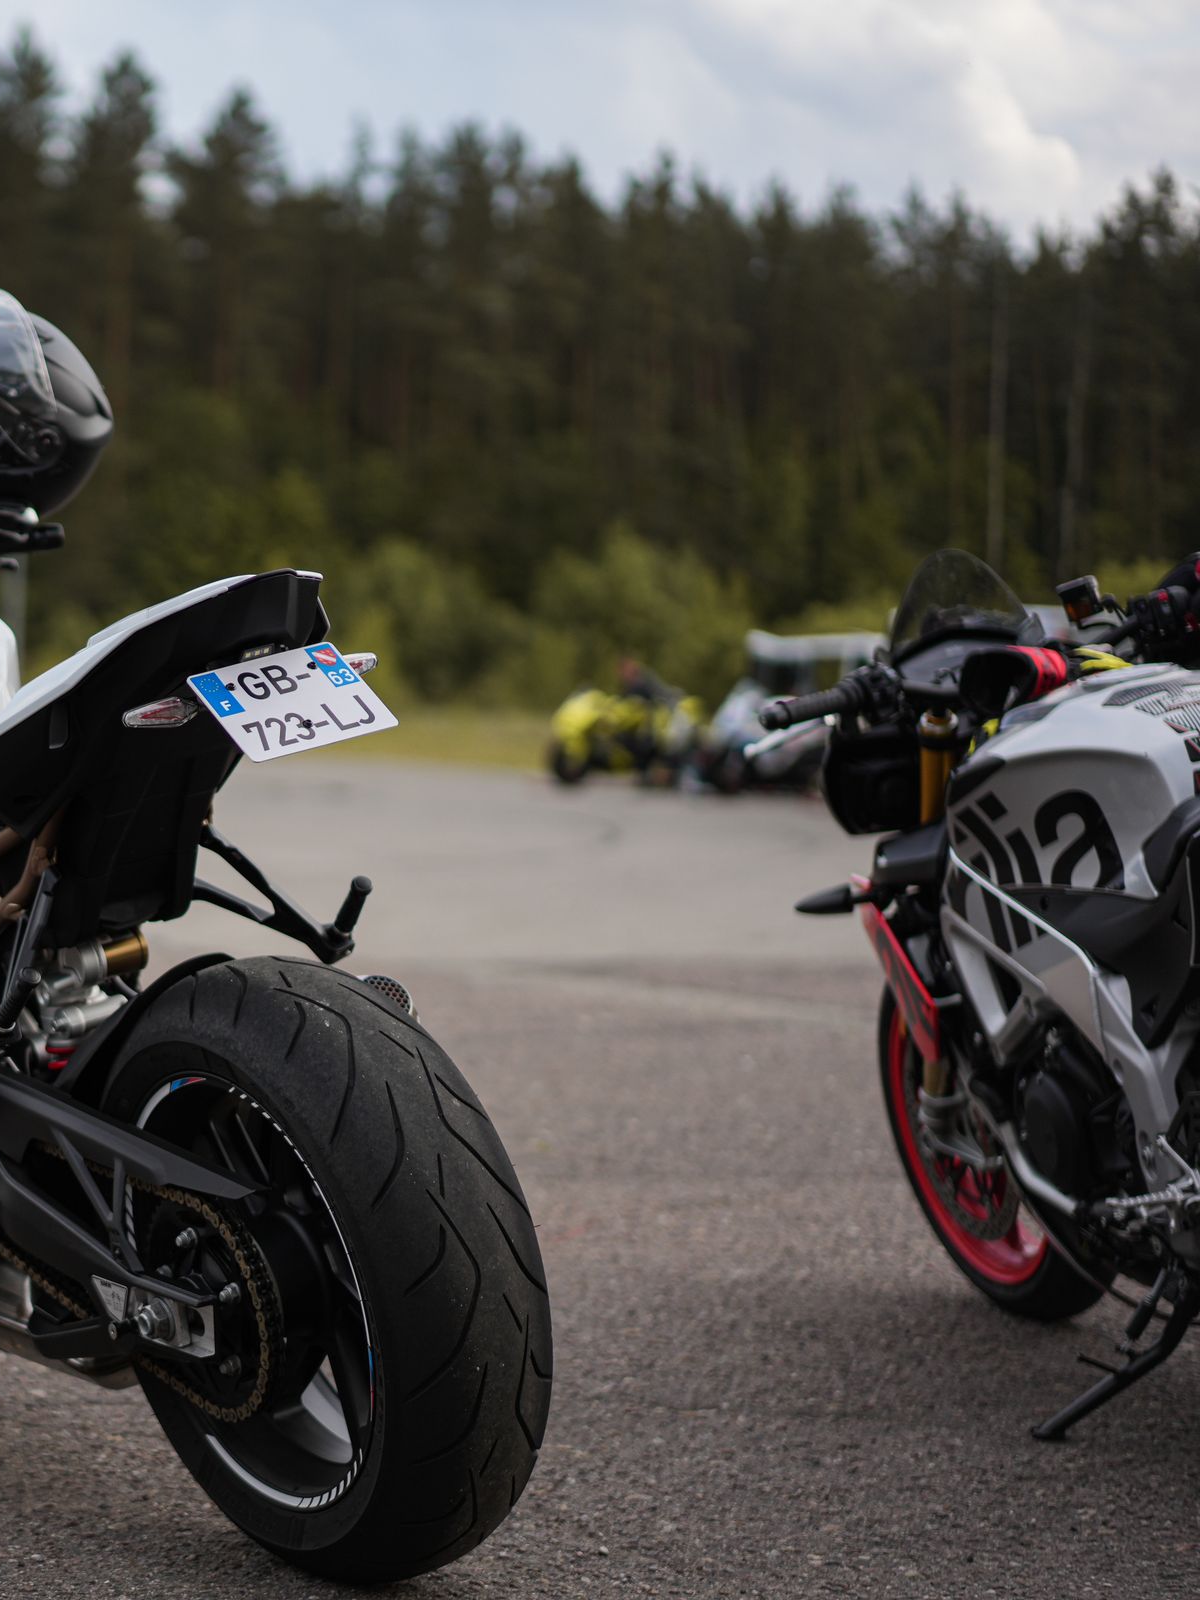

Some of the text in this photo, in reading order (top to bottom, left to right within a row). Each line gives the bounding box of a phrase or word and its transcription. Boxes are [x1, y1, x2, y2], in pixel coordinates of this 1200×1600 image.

[328, 668, 356, 685] 63
[219, 700, 232, 712] F
[241, 695, 376, 751] 723-LJ
